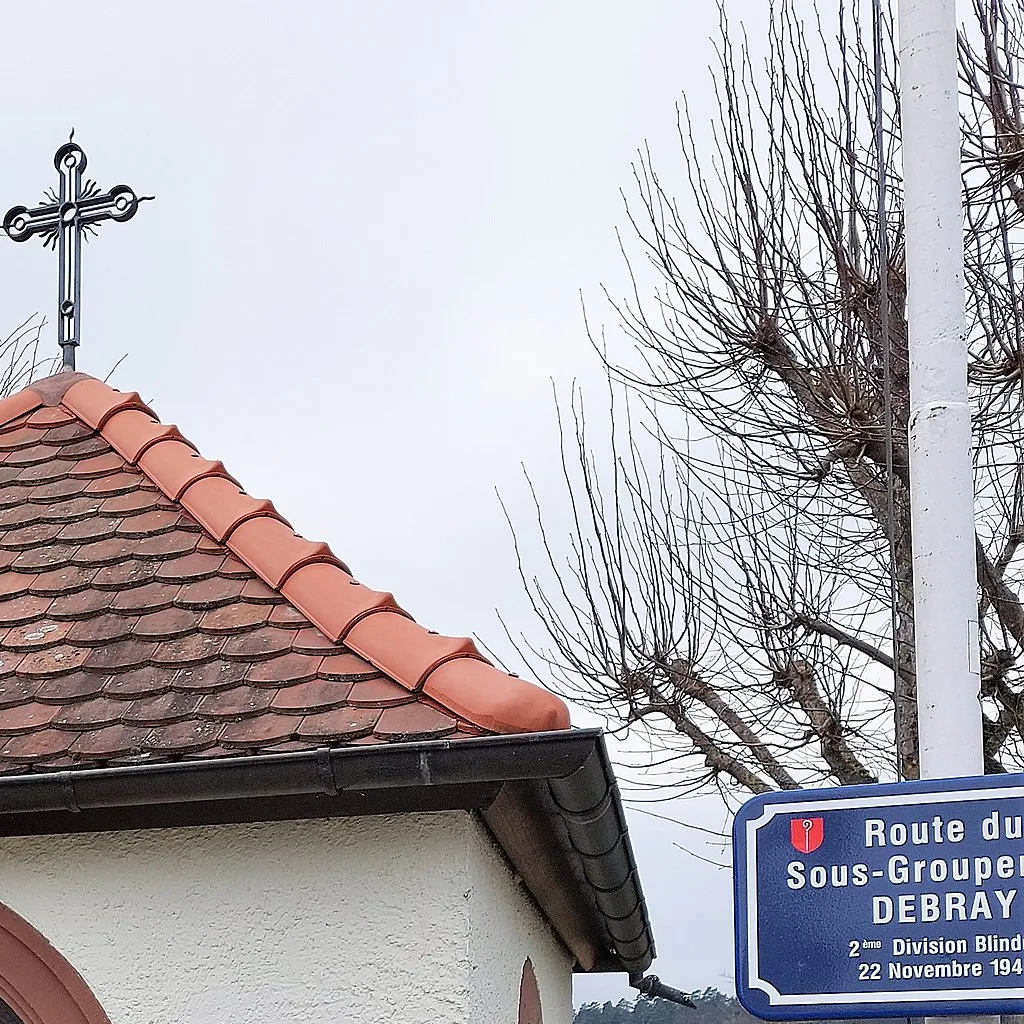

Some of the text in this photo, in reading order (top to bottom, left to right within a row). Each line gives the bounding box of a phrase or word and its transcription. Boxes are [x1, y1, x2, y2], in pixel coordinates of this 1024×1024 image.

[865, 810, 1023, 847] Route du
[872, 890, 1017, 924] DEBRAY
[849, 934, 1024, 957] 2ème Division Blind
[858, 963, 881, 980] 22
[888, 960, 983, 979] Novembre
